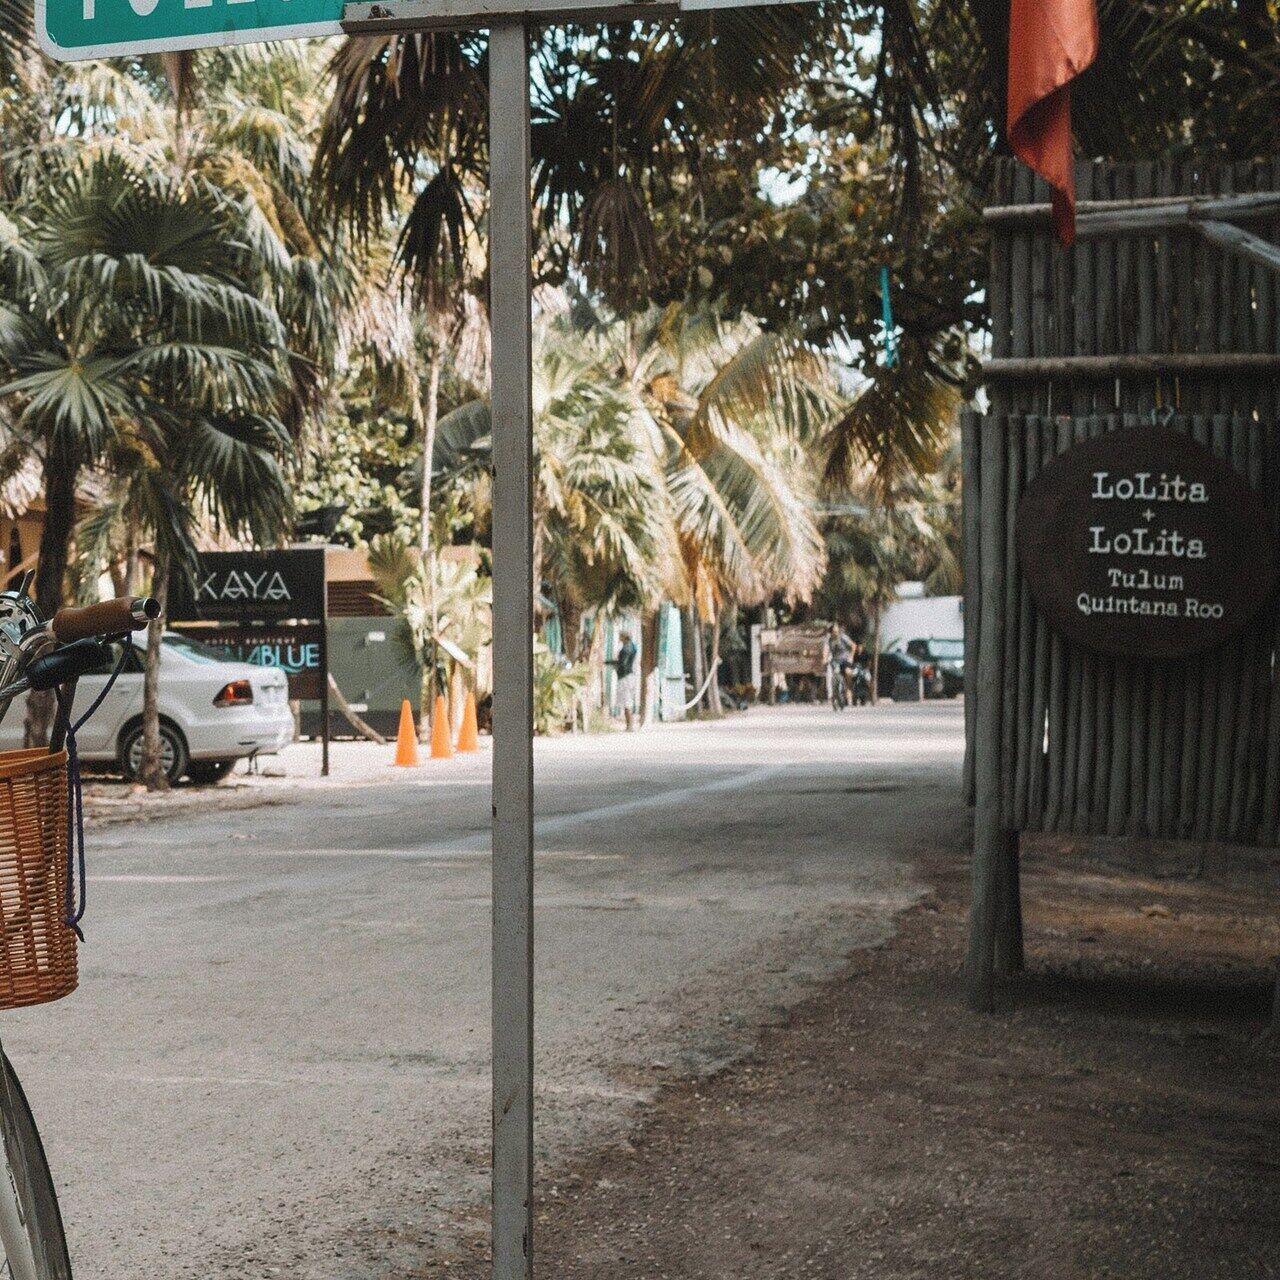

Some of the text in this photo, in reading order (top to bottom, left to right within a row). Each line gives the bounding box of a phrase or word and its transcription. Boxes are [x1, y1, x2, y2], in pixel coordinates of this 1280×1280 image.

[1091, 472, 1209, 502] LoLita
[1088, 526, 1207, 558] LoLita
[193, 570, 292, 601] KAYA
[1107, 568, 1184, 591] Tulum
[1076, 592, 1224, 618] Quintana Roo
